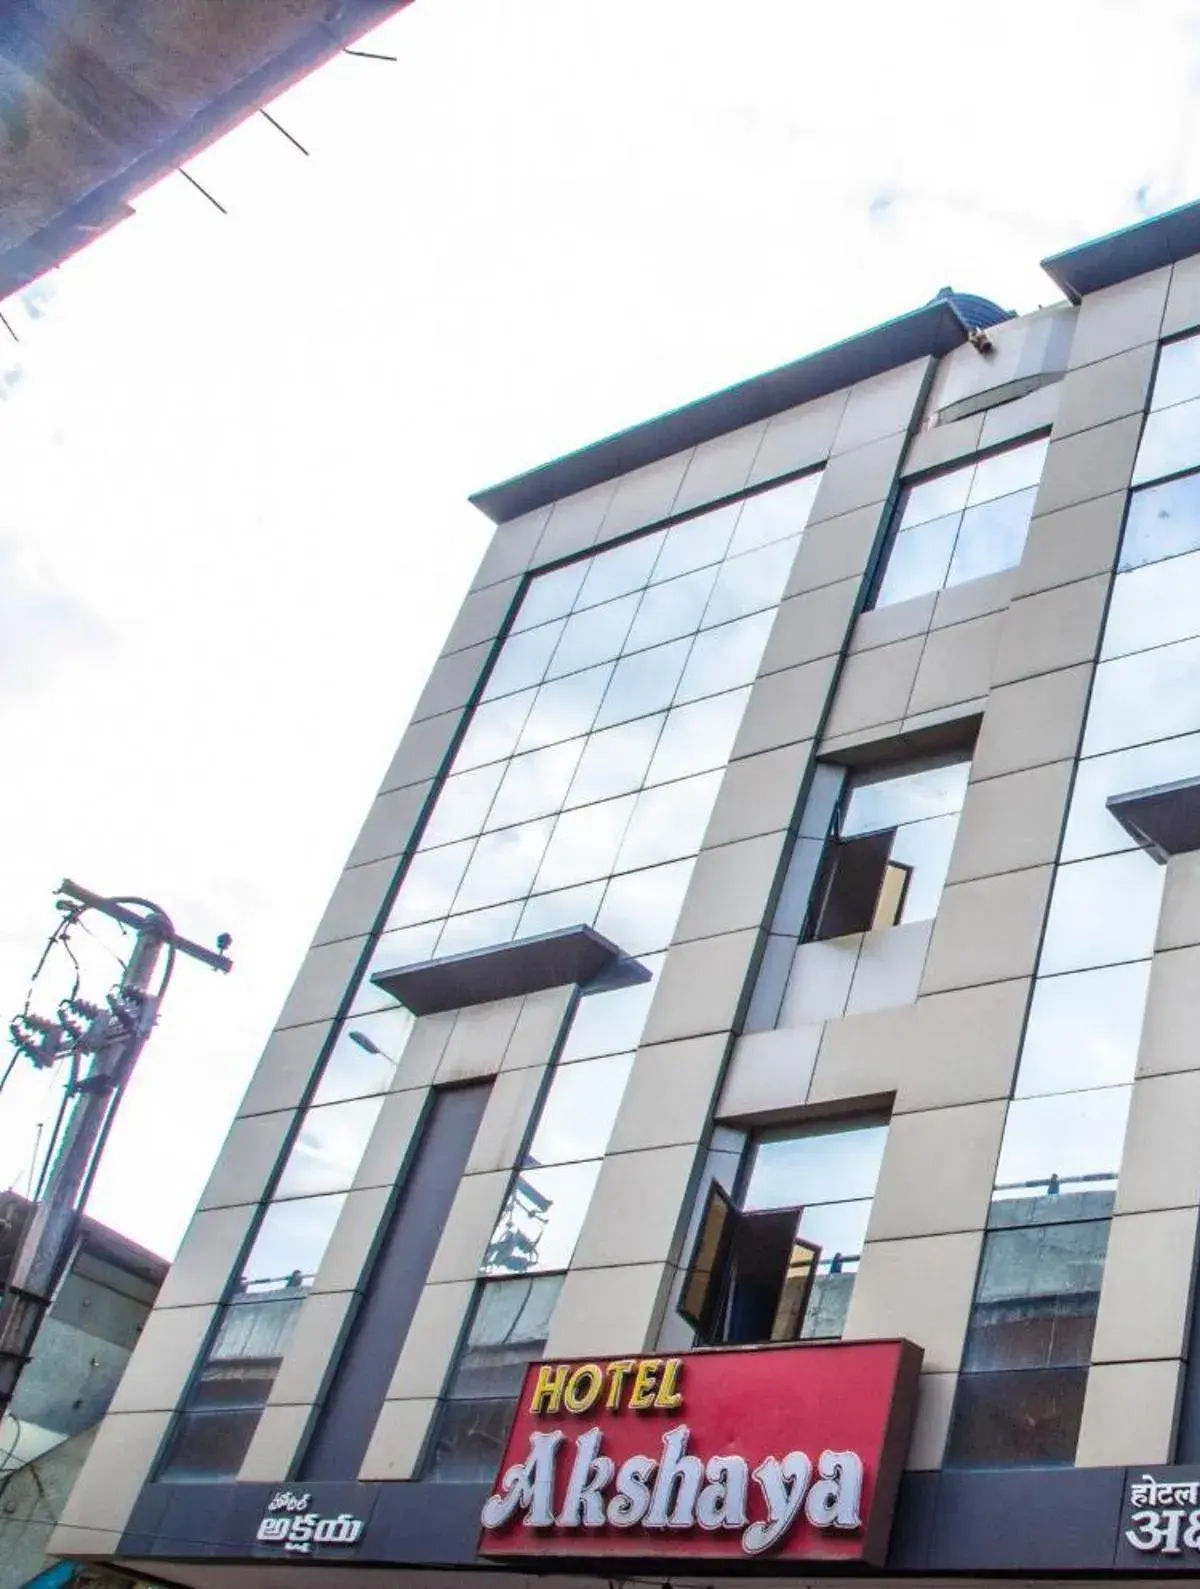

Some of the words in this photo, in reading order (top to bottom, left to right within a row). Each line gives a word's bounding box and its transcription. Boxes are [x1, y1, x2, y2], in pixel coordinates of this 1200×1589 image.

[528, 1357, 685, 1415] HOTEL
[480, 1423, 865, 1557] Akshaya
[256, 1513, 365, 1554] అక్షయ
